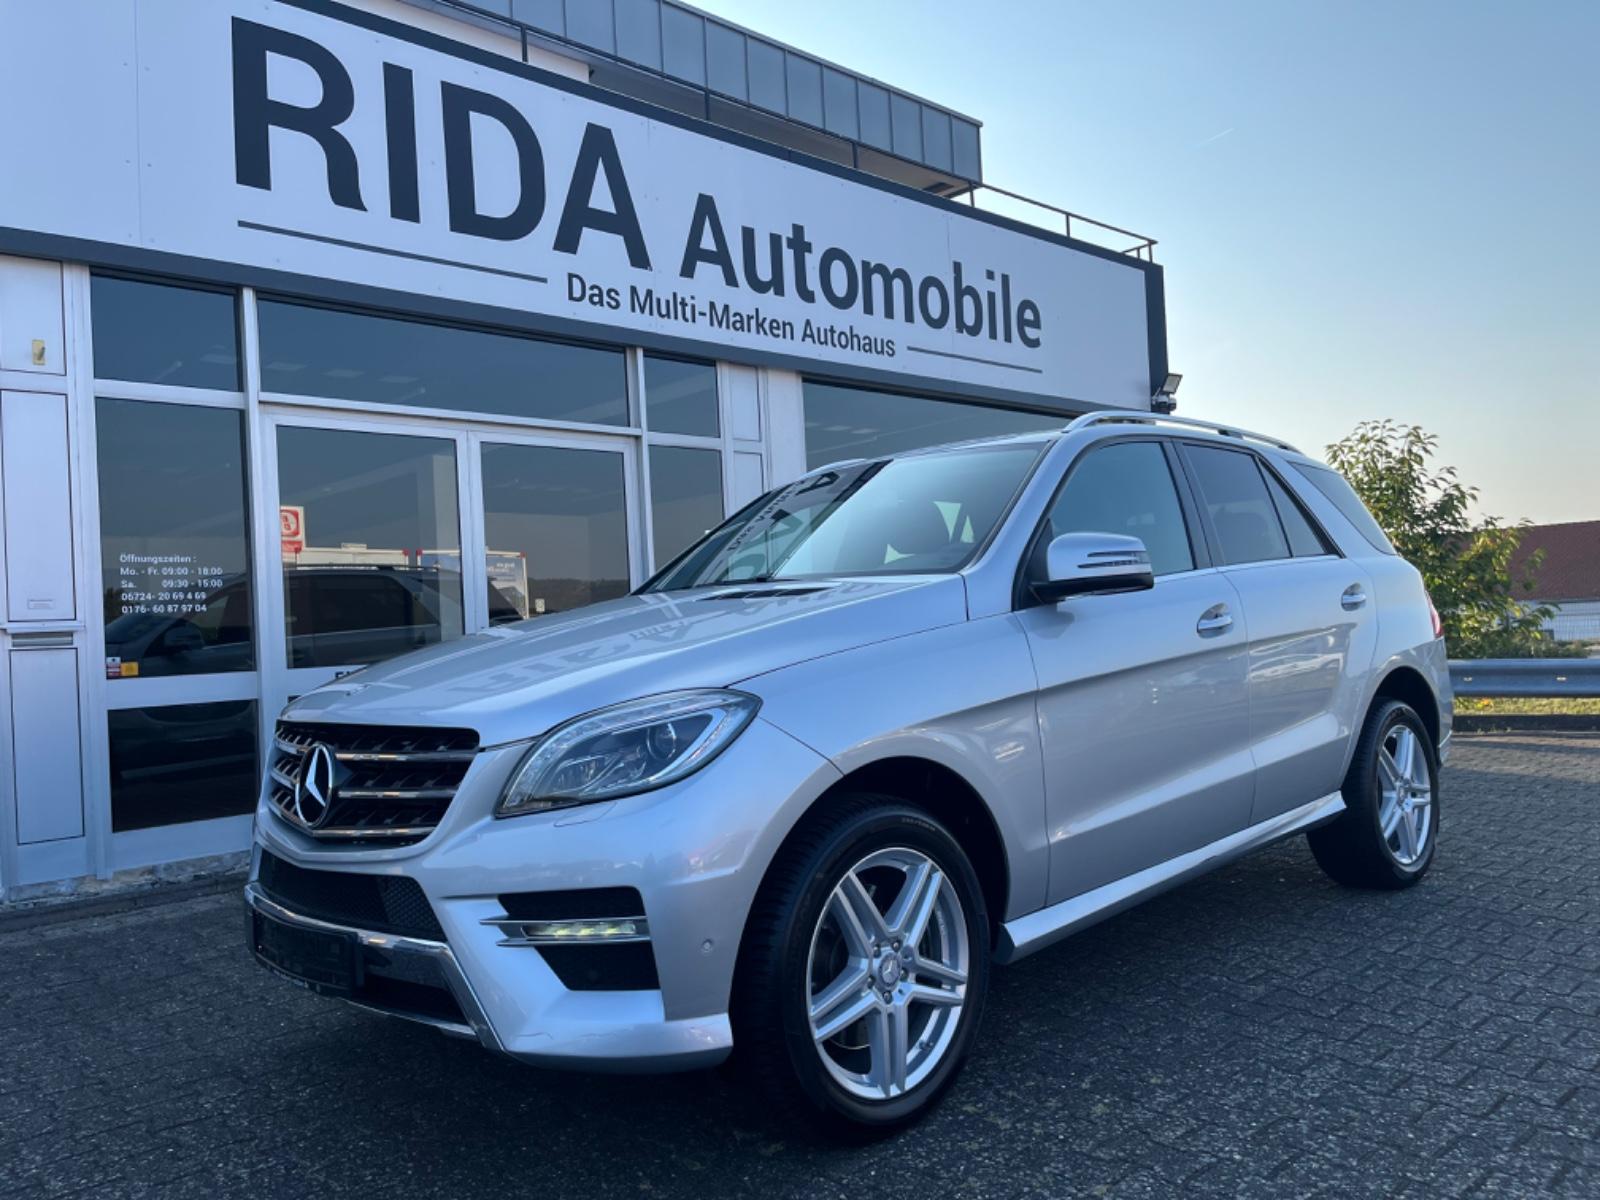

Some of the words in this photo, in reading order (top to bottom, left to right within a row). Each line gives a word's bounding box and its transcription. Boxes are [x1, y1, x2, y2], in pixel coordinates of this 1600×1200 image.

[231, 15, 653, 272] RIDA
[680, 192, 1042, 349] Automobile
[567, 272, 622, 310] Das
[629, 285, 795, 342] Multi-Marken
[801, 325, 896, 357] Autohaus
[120, 567, 139, 576] Mo.
[147, 567, 160, 576] Fr.
